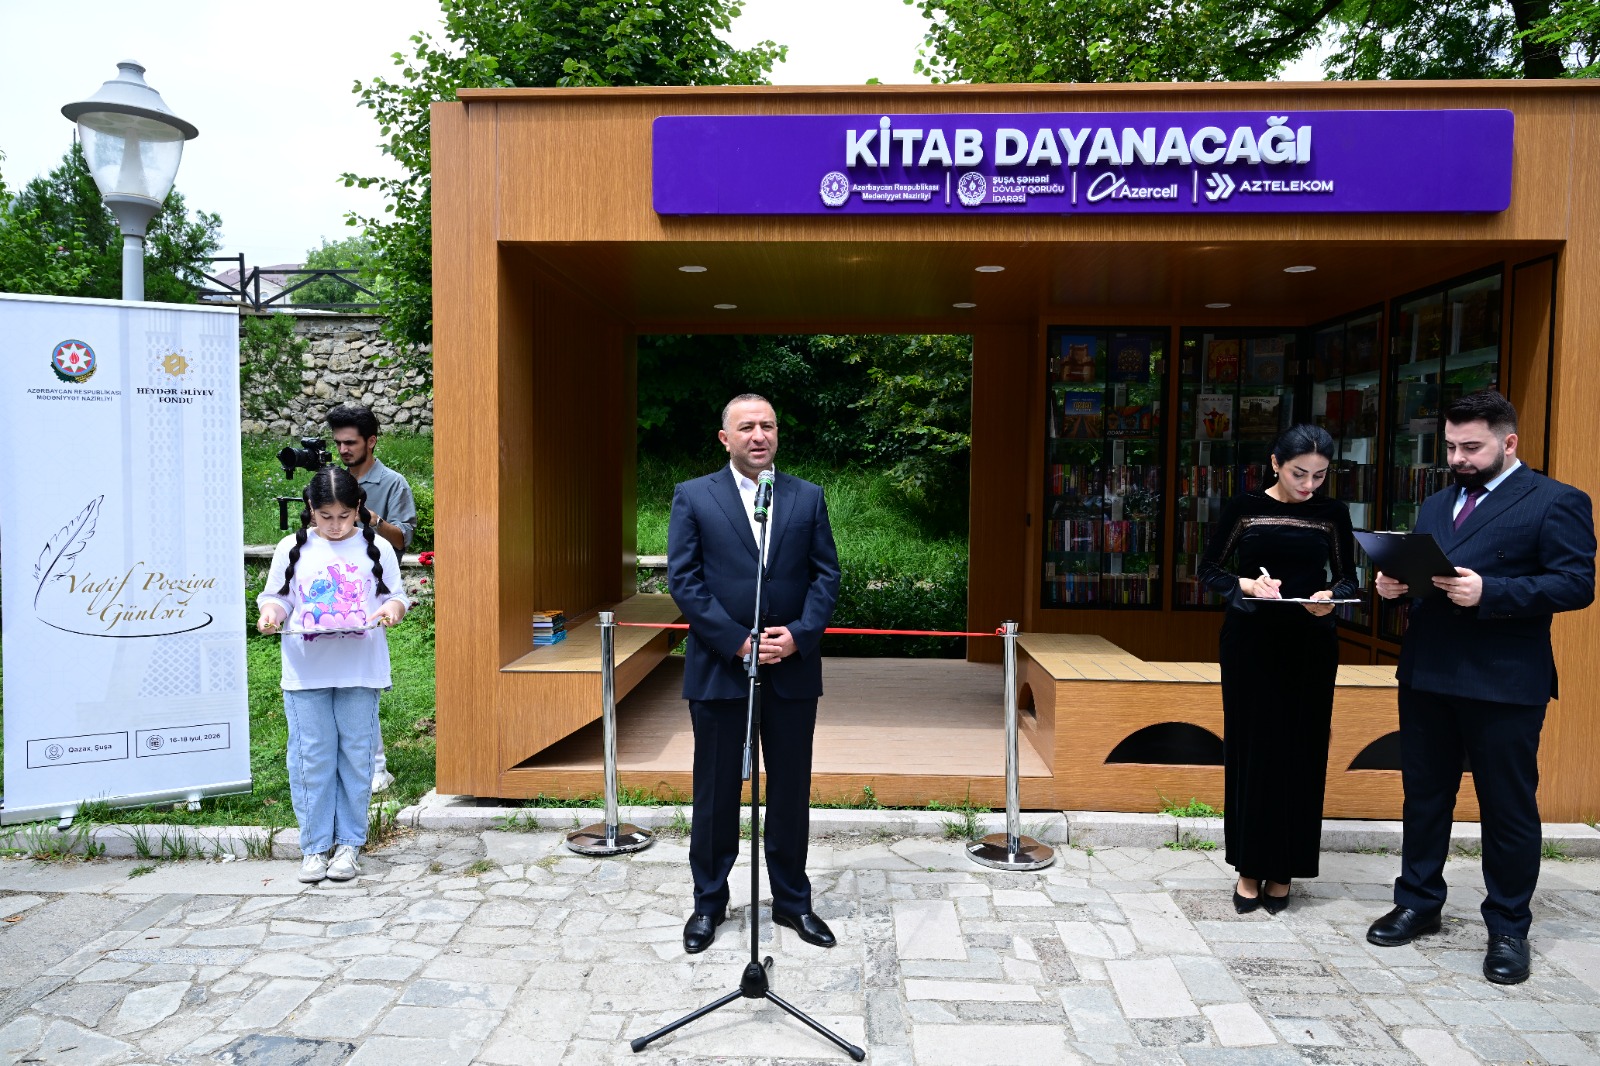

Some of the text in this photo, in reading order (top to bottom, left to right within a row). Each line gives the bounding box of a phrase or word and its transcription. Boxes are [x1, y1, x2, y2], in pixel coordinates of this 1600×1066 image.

[846, 115, 1312, 167] KİTAB DAYANACAĞI
[992, 174, 1050, 185] ŞUŞA ŞƏHƏRİ
[992, 183, 1065, 194] DÖVLƏT QORUĞU
[1120, 184, 1178, 199] Azercell
[1240, 180, 1334, 192] AZTELEKOM
[992, 194, 1027, 203] İDARƏSİ
[136, 387, 215, 396] HEYDƏR ƏLİYEV
[159, 397, 194, 405] FONDU
[65, 561, 219, 615] Vaqif Poeziya
[100, 593, 190, 632] Günləri
[94, 744, 112, 752] Şuşa
